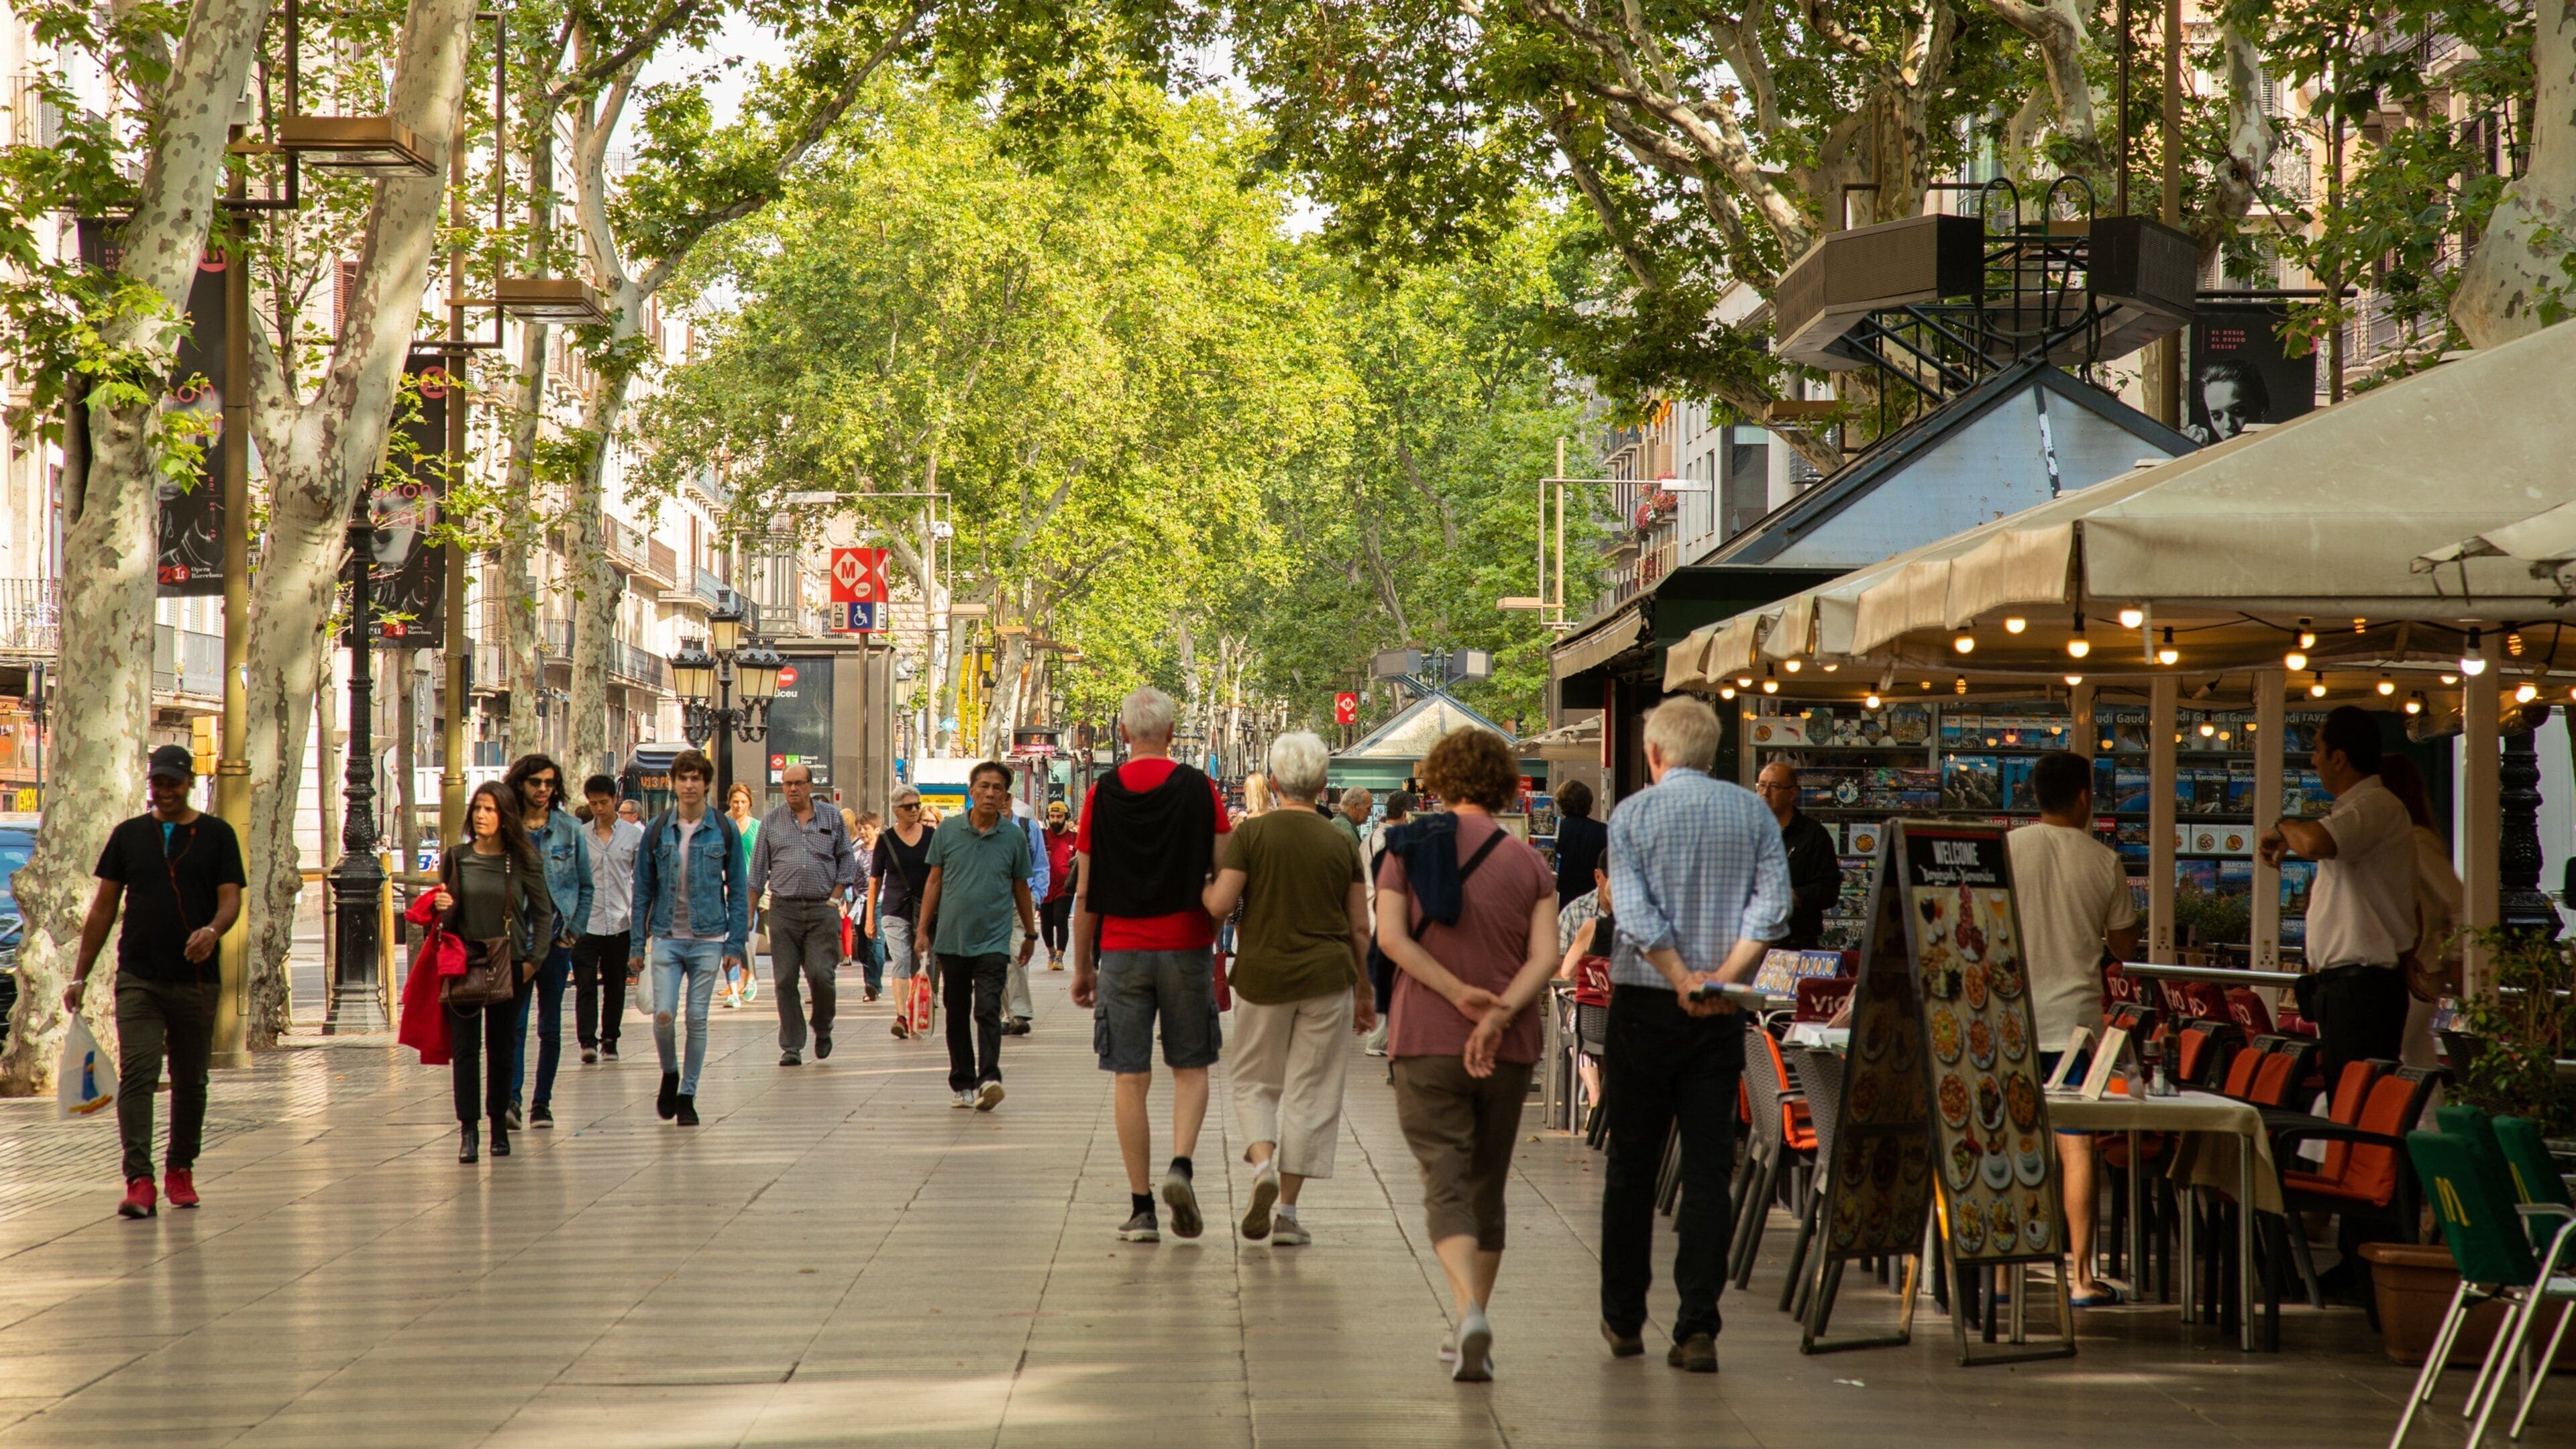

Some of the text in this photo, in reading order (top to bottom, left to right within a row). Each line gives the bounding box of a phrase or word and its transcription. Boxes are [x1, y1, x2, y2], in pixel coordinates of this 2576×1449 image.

[841, 561, 855, 578] M
[1984, 818, 2007, 826] AUDÍ
[1931, 841, 1980, 865] WELCOME
